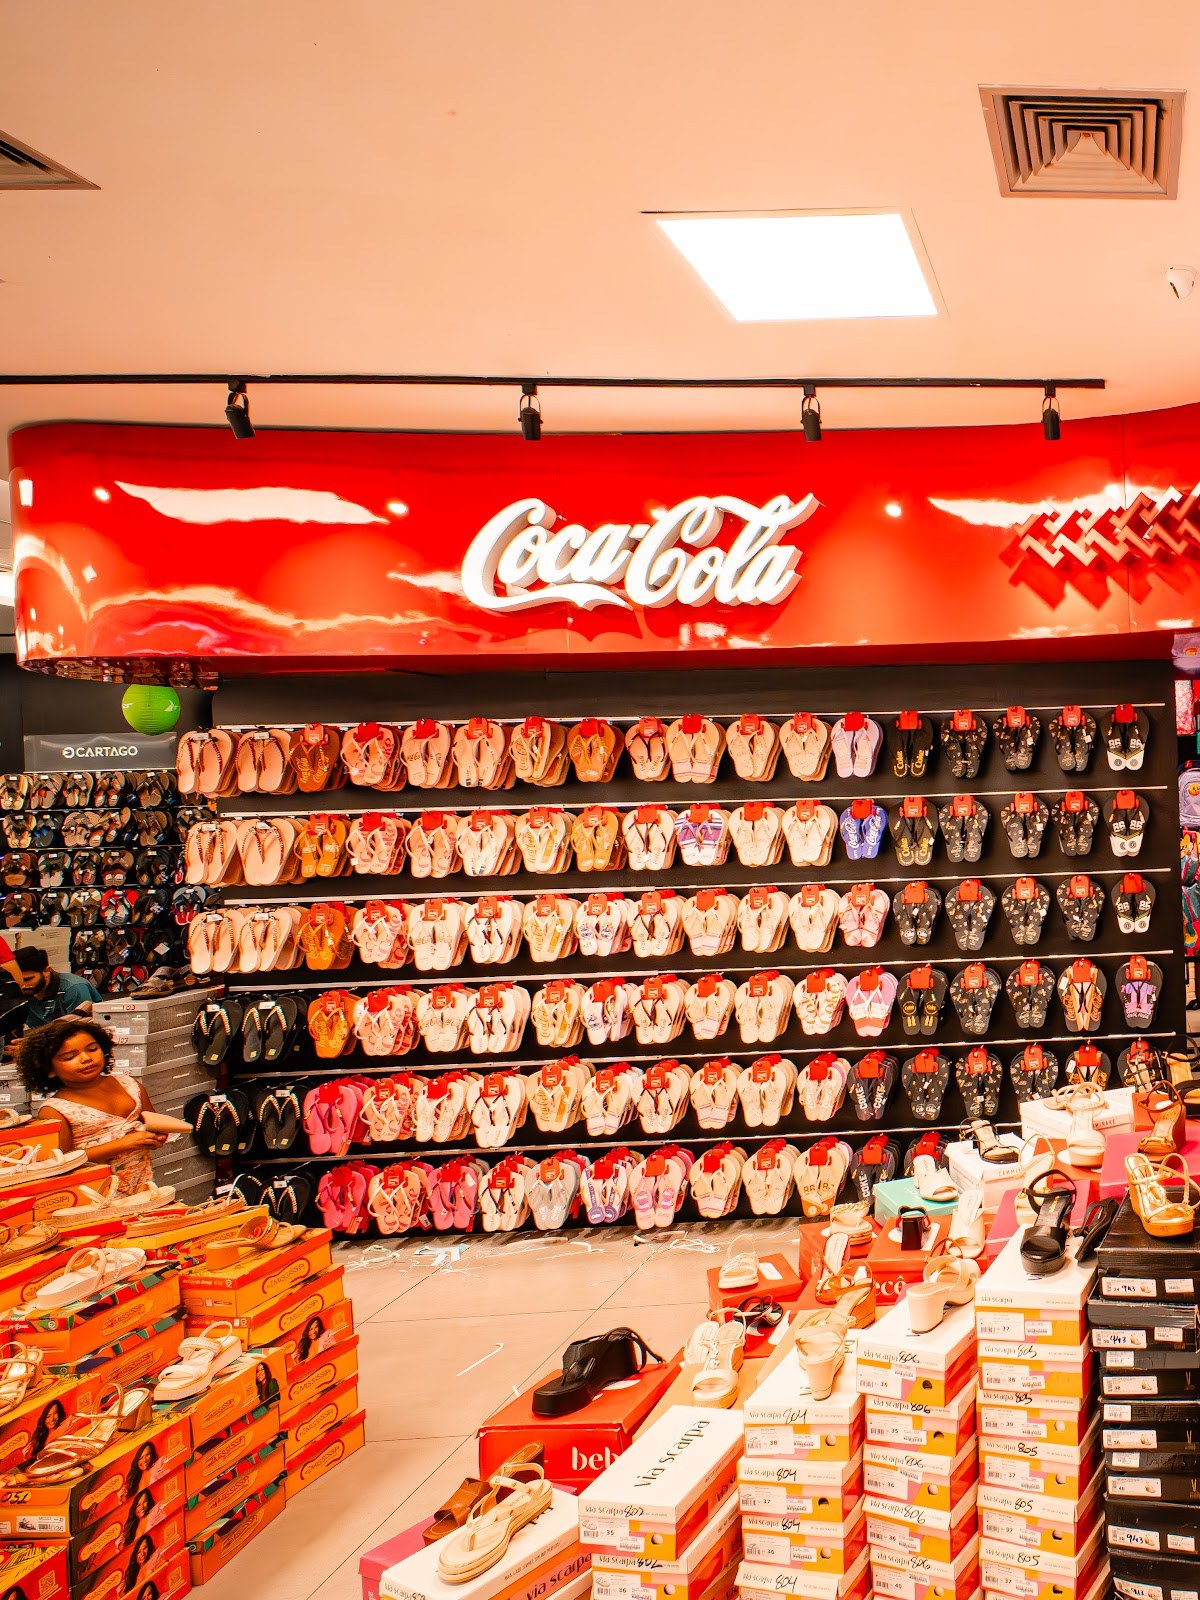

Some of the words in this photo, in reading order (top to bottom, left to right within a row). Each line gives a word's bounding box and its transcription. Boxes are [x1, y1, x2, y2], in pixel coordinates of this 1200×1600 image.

[461, 492, 824, 611] Coca-Cola
[76, 745, 138, 757] CARTAGO
[855, 1086, 868, 1110] COKE
[859, 1173, 870, 1198] COKE
[34, 1195, 70, 1210] SSISSIPI
[874, 1275, 906, 1296] ecê
[863, 1349, 874, 1358] via
[875, 1350, 899, 1362] scarpa
[873, 1397, 884, 1406] via
[885, 1398, 909, 1411] scarpa
[633, 1464, 664, 1488] via
[658, 1419, 711, 1464] scarpa
[1017, 1442, 1039, 1456] 805
[571, 1447, 620, 1471] beb
[776, 1467, 797, 1482] 804
[597, 1507, 624, 1517] scarpa
[1014, 1496, 1034, 1512] 805
[903, 1504, 926, 1525] 806
[599, 1555, 610, 1563] via
[611, 1557, 636, 1567] scarpa
[1017, 1551, 1040, 1566] 805
[549, 1553, 592, 1587] scarpa
[775, 1573, 798, 1593] 804
